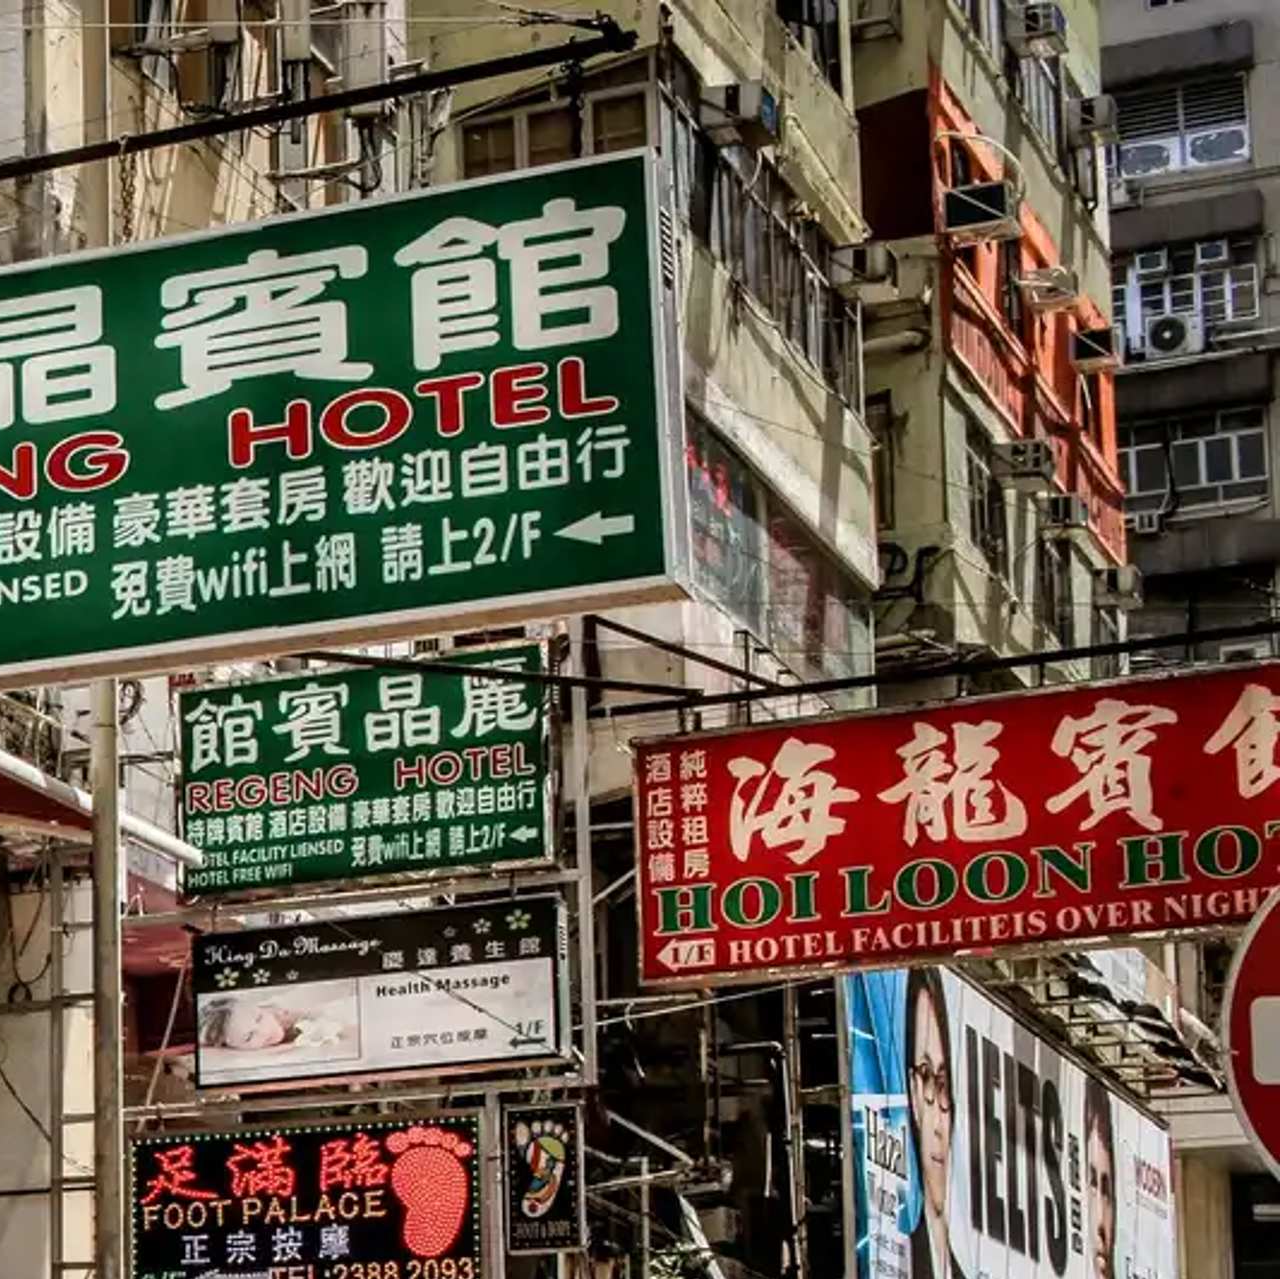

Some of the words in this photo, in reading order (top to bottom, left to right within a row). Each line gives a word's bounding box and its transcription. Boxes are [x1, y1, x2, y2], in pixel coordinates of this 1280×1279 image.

[226, 357, 618, 469] HOTEL
[110, 467, 327, 550] 豪華套房
[342, 424, 630, 517] 歡迎自由行
[187, 764, 358, 815] REGENG
[395, 742, 535, 789] HOTEL
[645, 751, 676, 884] 酒店設備
[232, 866, 262, 884] FREE
[655, 871, 820, 937] HOI
[839, 841, 1100, 918] LOON
[729, 931, 842, 965] HOTEL
[851, 910, 1046, 954] FACILITEIS
[1056, 897, 1154, 932] OVER
[375, 979, 430, 1000] Health
[434, 971, 511, 995] Massage
[965, 1023, 1068, 1278] IELTS
[142, 1199, 233, 1231] FOOT
[242, 1189, 387, 1227] PALACE
[181, 1225, 351, 1266] 正宗按摩
